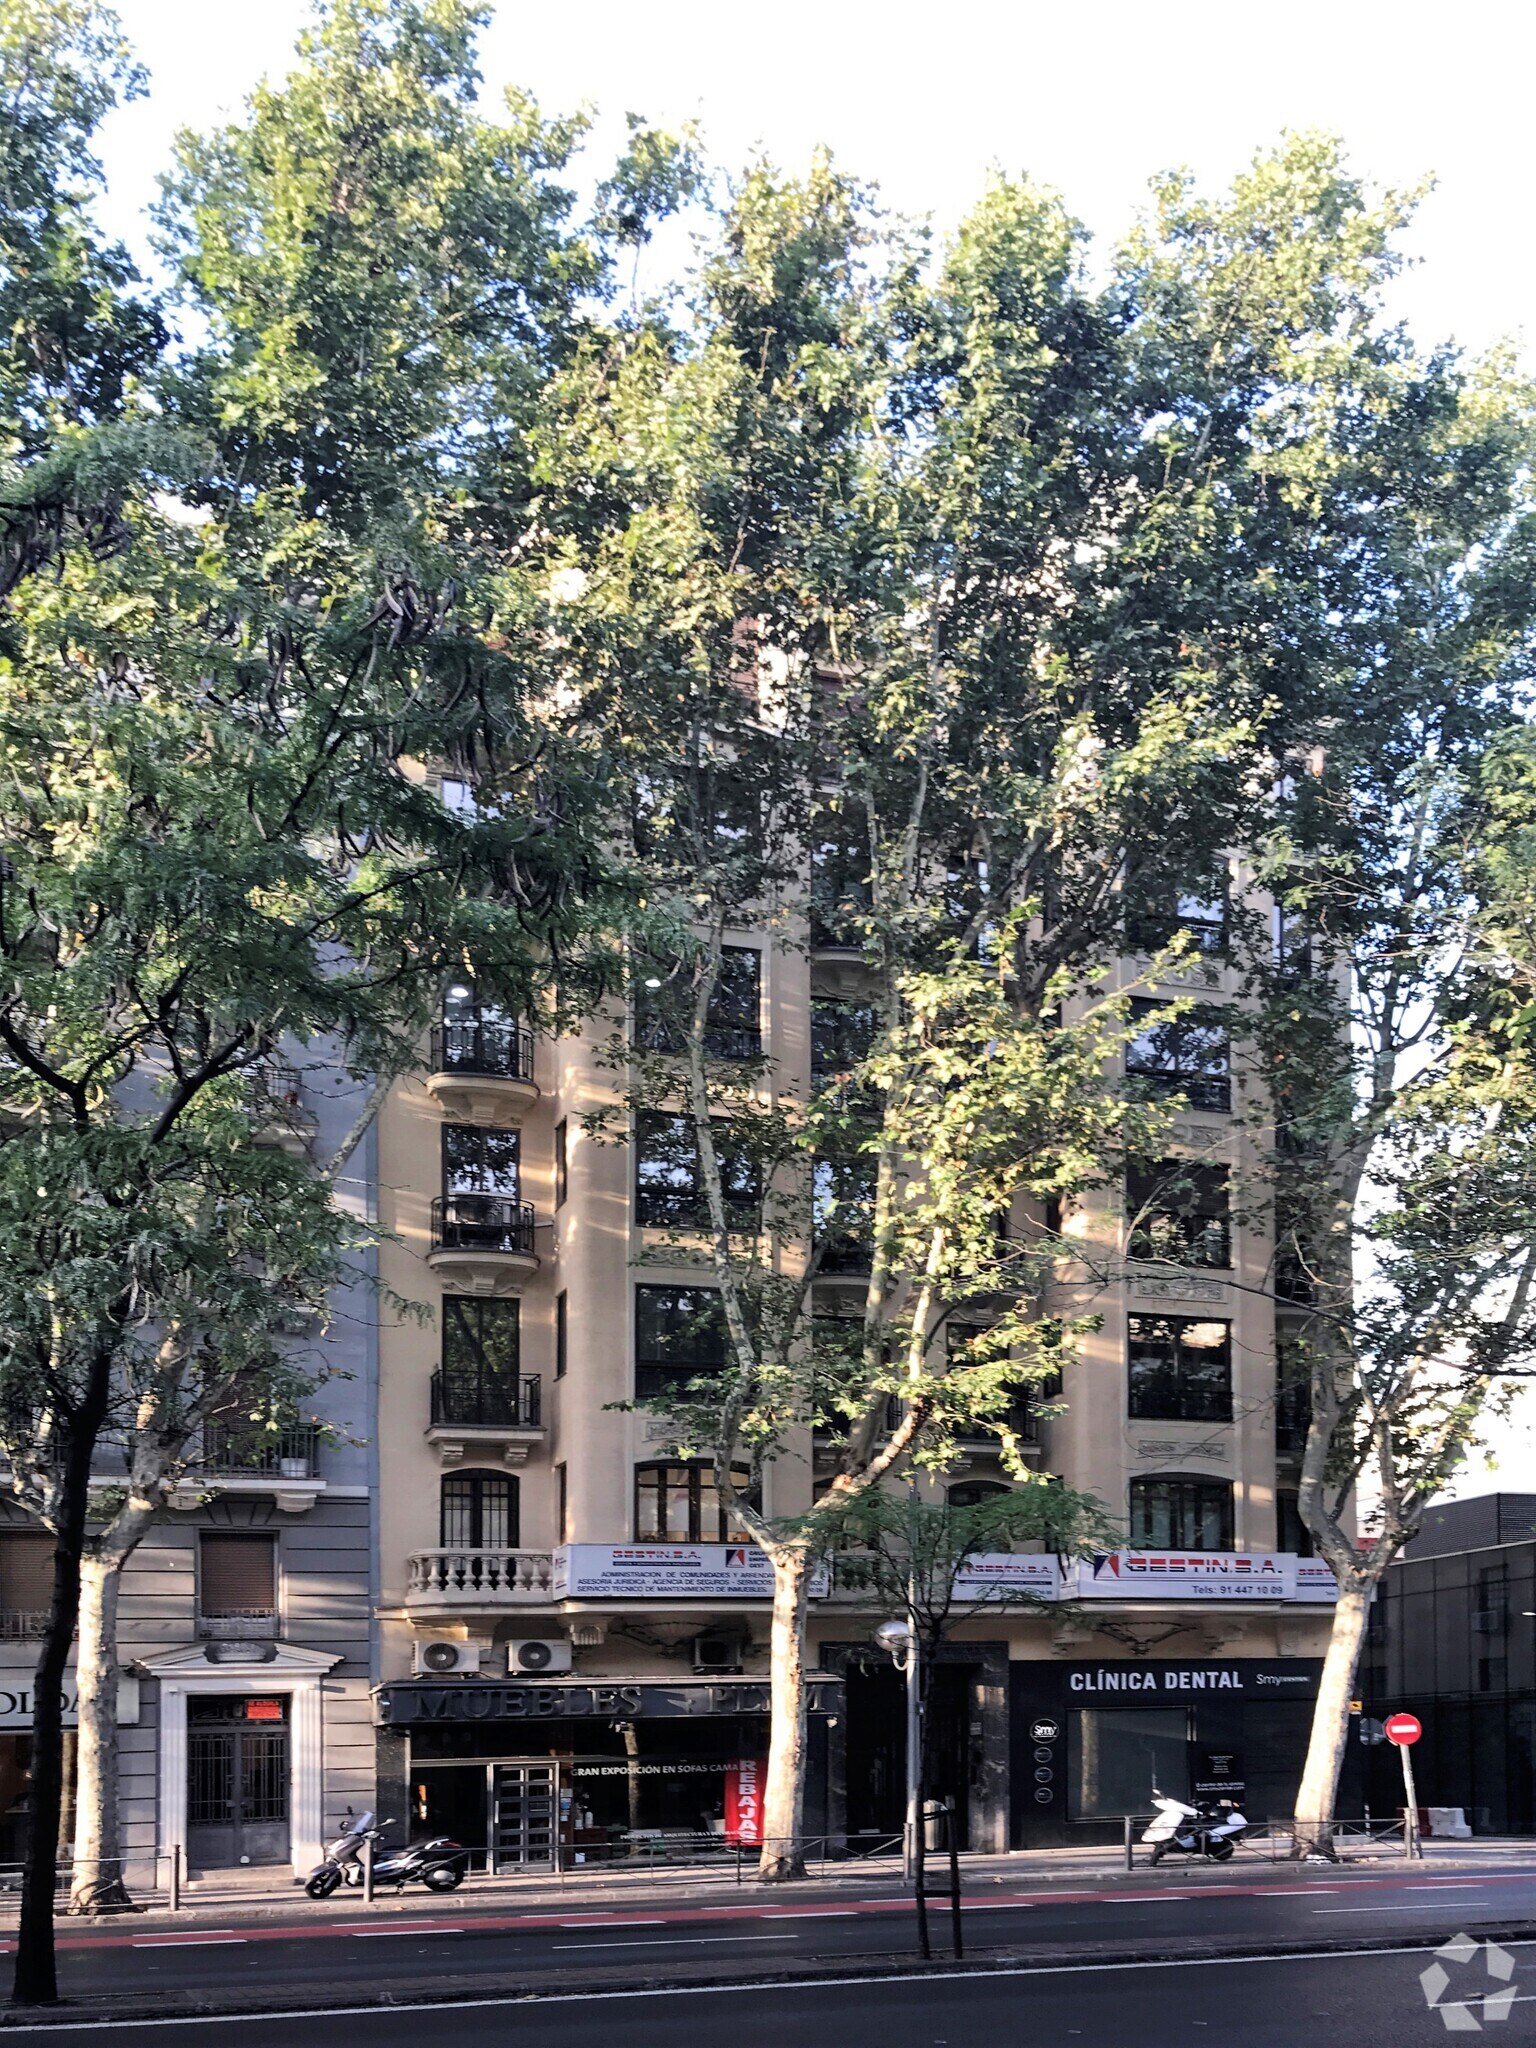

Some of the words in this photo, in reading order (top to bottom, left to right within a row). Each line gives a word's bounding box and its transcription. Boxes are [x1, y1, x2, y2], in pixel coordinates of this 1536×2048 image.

[1220, 1585, 1232, 1594] 91
[1234, 1585, 1253, 1594] 447
[1070, 1669, 1157, 1690] CLÍNICA
[1165, 1671, 1244, 1689] DENTAL
[412, 1686, 643, 1718] MUEBLES
[570, 1767, 599, 1777] GRAN
[601, 1765, 661, 1776] EXPOSICIÓN
[662, 1765, 676, 1774] EN
[737, 1760, 758, 1843] REBAJAS
